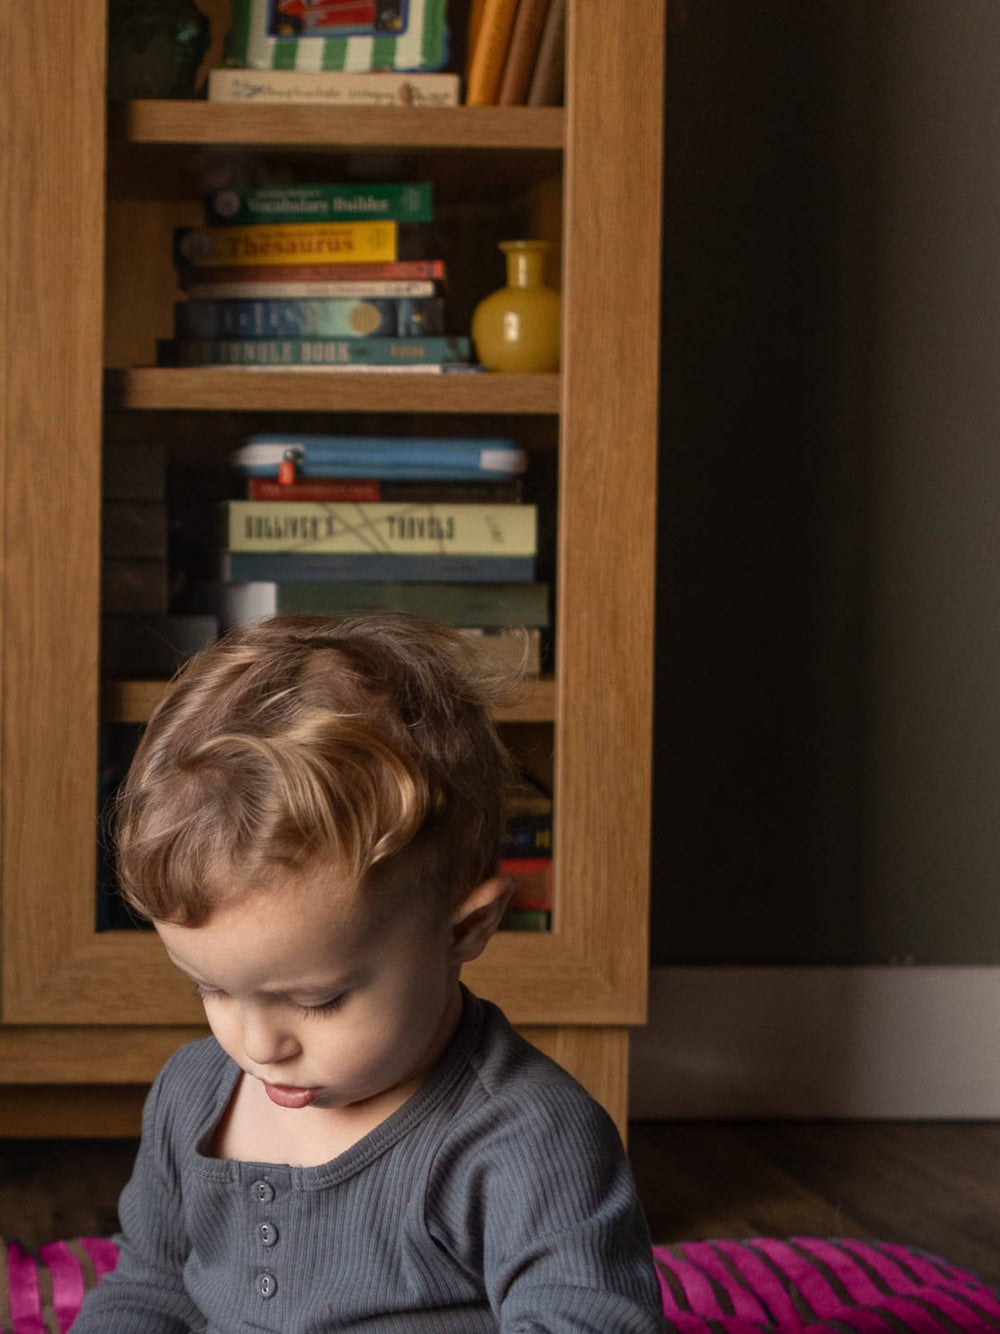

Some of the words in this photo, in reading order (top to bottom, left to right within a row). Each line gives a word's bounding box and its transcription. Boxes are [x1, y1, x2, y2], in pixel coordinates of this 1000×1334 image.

[247, 197, 328, 215] Vocabulary
[333, 195, 390, 212] Builder
[230, 237, 354, 258] Thesaurus
[300, 341, 349, 362] BOOK
[388, 516, 456, 539] TRAVELS
